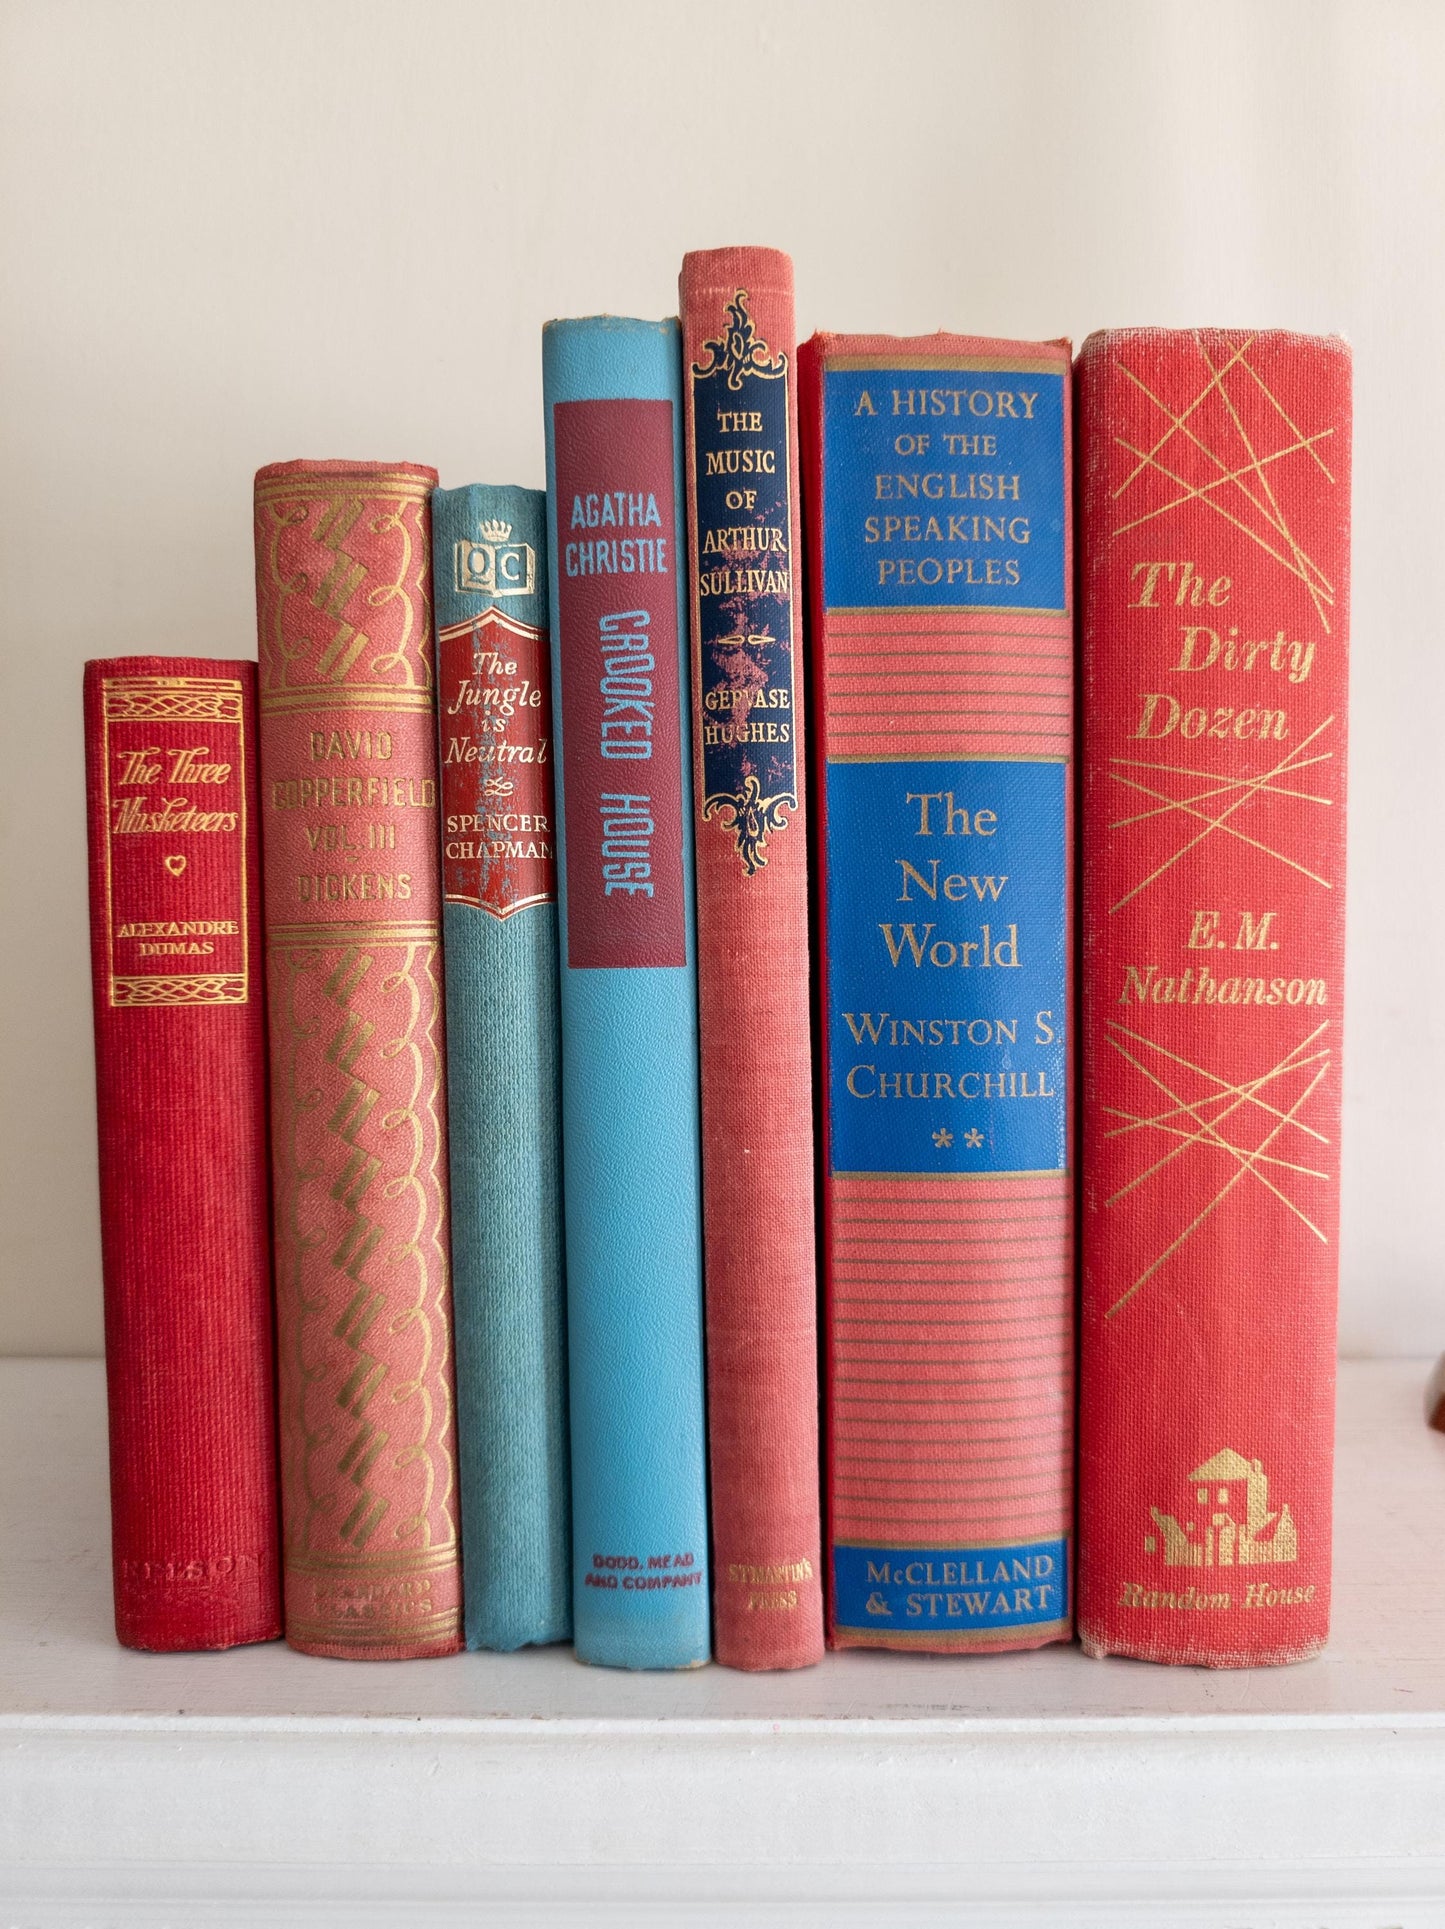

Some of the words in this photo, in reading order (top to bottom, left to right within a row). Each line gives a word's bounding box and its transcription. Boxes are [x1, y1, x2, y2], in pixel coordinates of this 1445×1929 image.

[854, 390, 878, 416] A
[892, 389, 1038, 419] HISTORY
[717, 412, 763, 433] THE
[895, 433, 930, 456] OF
[943, 434, 997, 456] THE
[706, 449, 776, 476] MUSIC
[725, 490, 757, 510] OF
[875, 473, 1020, 500] ENGLISH
[571, 491, 662, 529] AGATHA
[702, 526, 787, 554] ARTHUR
[865, 515, 1031, 544] SPEAKING
[565, 538, 668, 577] CHRISTIE
[878, 558, 1021, 586] PEOPLES
[700, 569, 788, 597] SULLIVAN
[1127, 561, 1232, 608] The
[473, 652, 518, 675] The
[1169, 625, 1316, 684] Dirty
[447, 680, 542, 716] Jungle
[599, 609, 656, 759] CROOKED
[481, 710, 507, 733] is
[1127, 694, 1289, 741] Dozen
[310, 730, 394, 761] DAVID
[704, 722, 790, 745] HUGHES
[445, 737, 548, 764] Neutral
[117, 747, 162, 785] The
[167, 746, 233, 784] Three
[272, 777, 437, 810] COPPERFIELD
[113, 797, 239, 834] Musketeers
[447, 815, 550, 833] SPENCER
[906, 792, 998, 836] The
[306, 824, 365, 851] VOL.
[370, 823, 396, 849] III
[446, 841, 553, 859] CHAPMAN
[599, 792, 655, 898] HOUSE
[298, 873, 413, 902] DICKENS
[895, 859, 1009, 901] New
[116, 920, 240, 938] ALEXANDRE
[139, 940, 215, 957] DUMAS
[879, 923, 1023, 968] World
[1116, 965, 1328, 1006] Nathanson
[622, 1571, 703, 1590] COMPANY
[865, 1592, 893, 1616] &
[906, 1584, 1052, 1617] STEWART
[1118, 1581, 1231, 1610] Random
[1241, 1582, 1316, 1609] House
